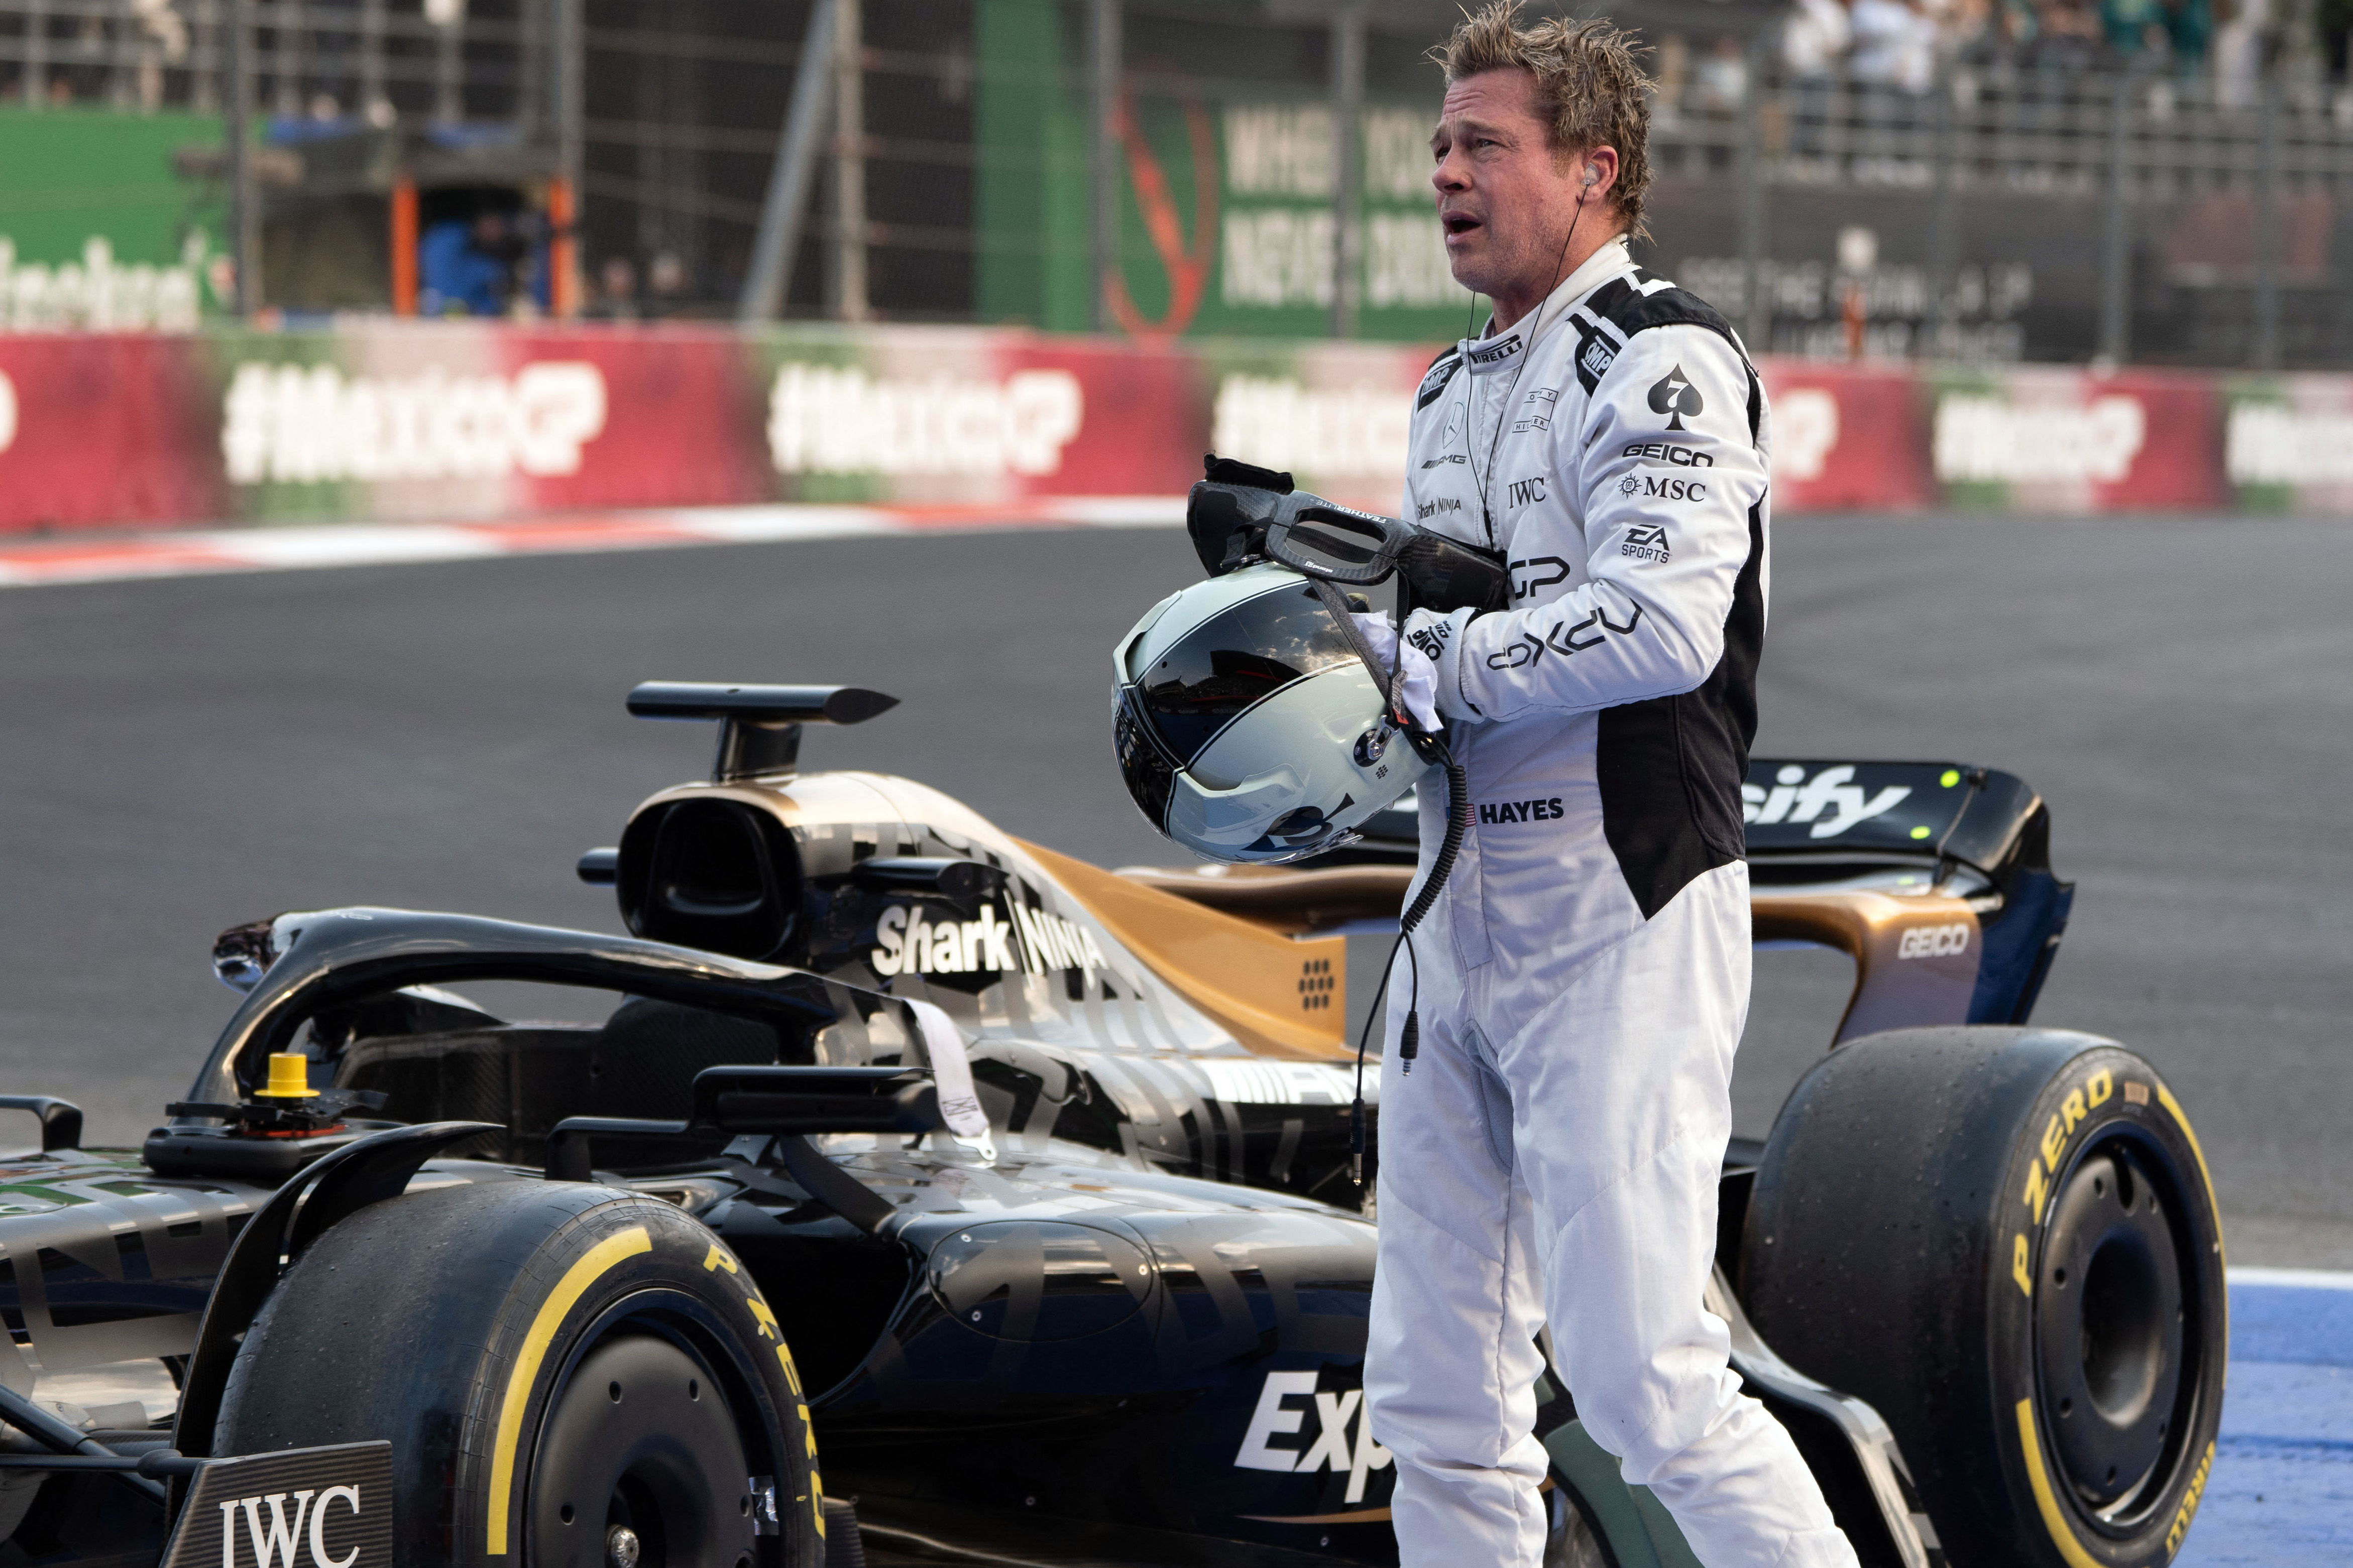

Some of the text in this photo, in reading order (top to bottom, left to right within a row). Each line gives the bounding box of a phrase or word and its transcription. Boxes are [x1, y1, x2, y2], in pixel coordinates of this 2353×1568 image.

[1469, 334, 1523, 364] PIRELLI
[1585, 341, 1611, 372] OMP
[1666, 378, 1690, 408] 7
[1437, 454, 1467, 465] AMG
[1622, 444, 1714, 467] GEICO
[1508, 477, 1546, 509] IWC
[1643, 476, 1706, 502] MSC
[1316, 500, 1387, 524] FEATHERLITE
[1624, 524, 1670, 551] EA
[1621, 544, 1669, 564] SPORTS
[1479, 797, 1564, 824] HAYES
[1741, 765, 1913, 839] sify
[870, 901, 1109, 990] Shark NINJA
[1898, 924, 1969, 959] GEICO
[2012, 1067, 2113, 1297] P ZERO
[703, 1243, 737, 1275] P
[1234, 1370, 1393, 1504] Exp
[219, 1484, 361, 1568] IWC
